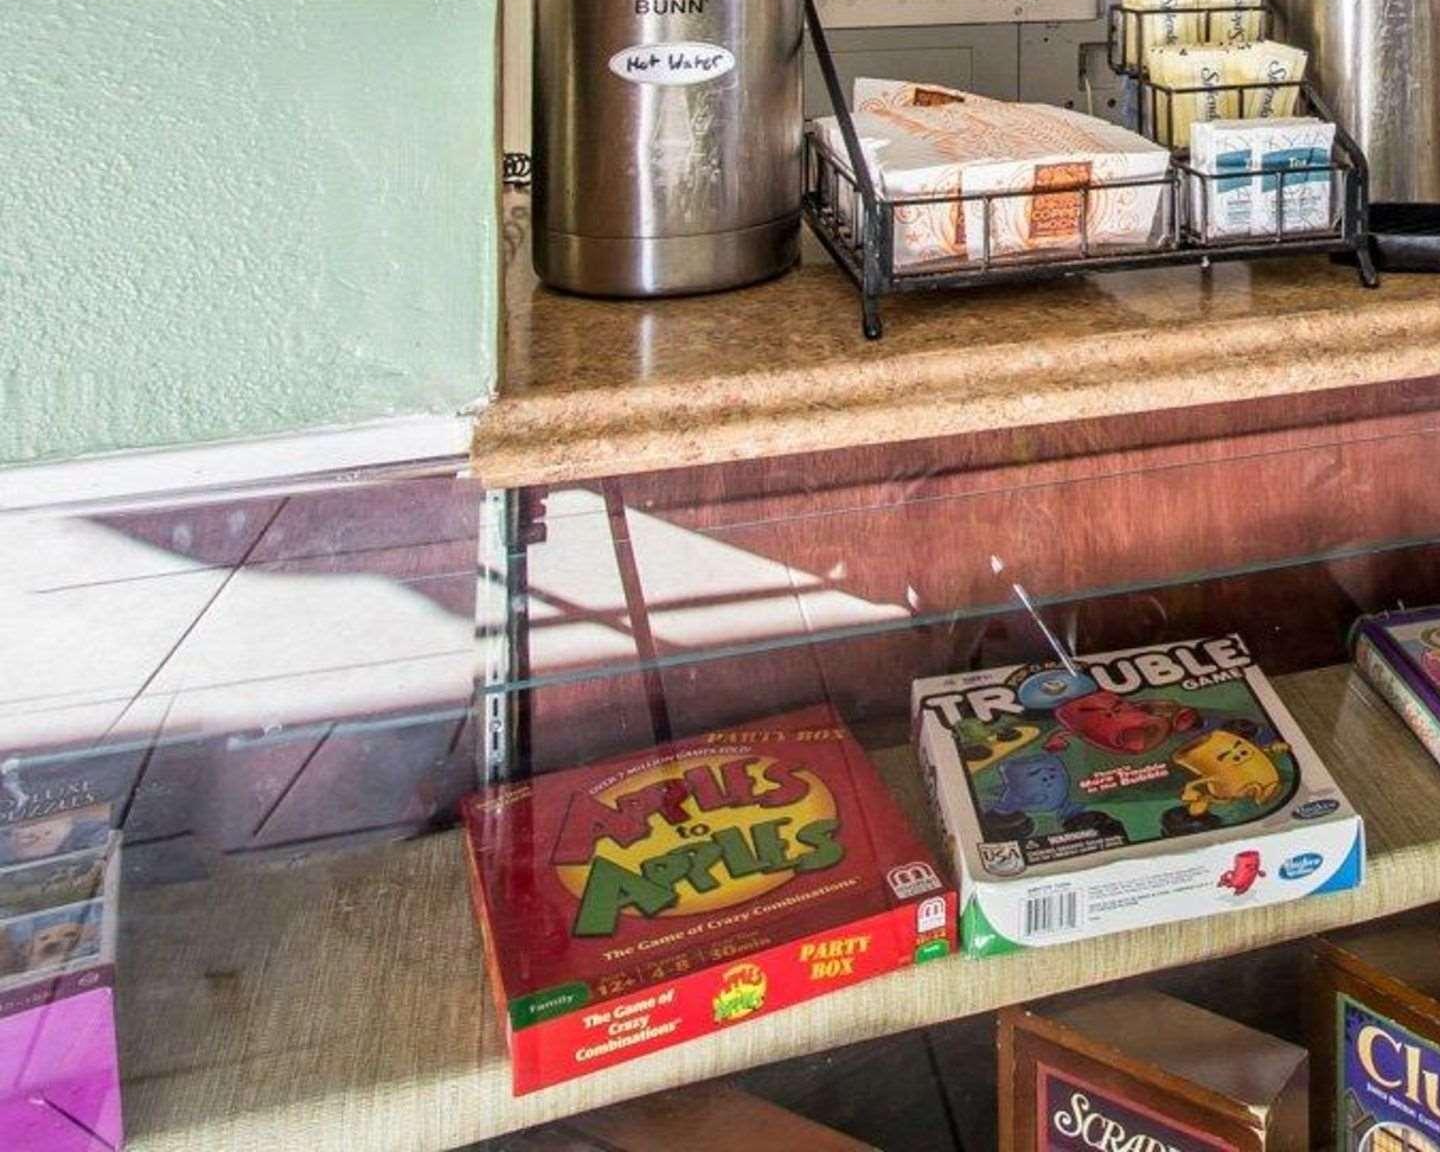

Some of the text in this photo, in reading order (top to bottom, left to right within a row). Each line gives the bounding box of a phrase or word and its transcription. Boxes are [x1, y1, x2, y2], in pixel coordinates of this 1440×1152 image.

[635, 0, 705, 15] BUNN
[626, 52, 724, 73] Hot Water
[1182, 667, 1244, 691] GAME
[707, 728, 846, 744] PARTY BOX
[552, 757, 812, 866] APPLES
[676, 822, 711, 839] to
[573, 816, 845, 938] APPLES
[603, 946, 636, 961] The
[637, 931, 685, 951] Game
[688, 923, 704, 936] of
[707, 911, 752, 931] Crazy
[753, 878, 858, 917] Combinations
[799, 934, 872, 961] PARTY
[810, 957, 856, 980] BOX
[529, 994, 574, 1013] Family
[582, 988, 675, 1029] The Game of
[608, 1014, 650, 1036] Crazy
